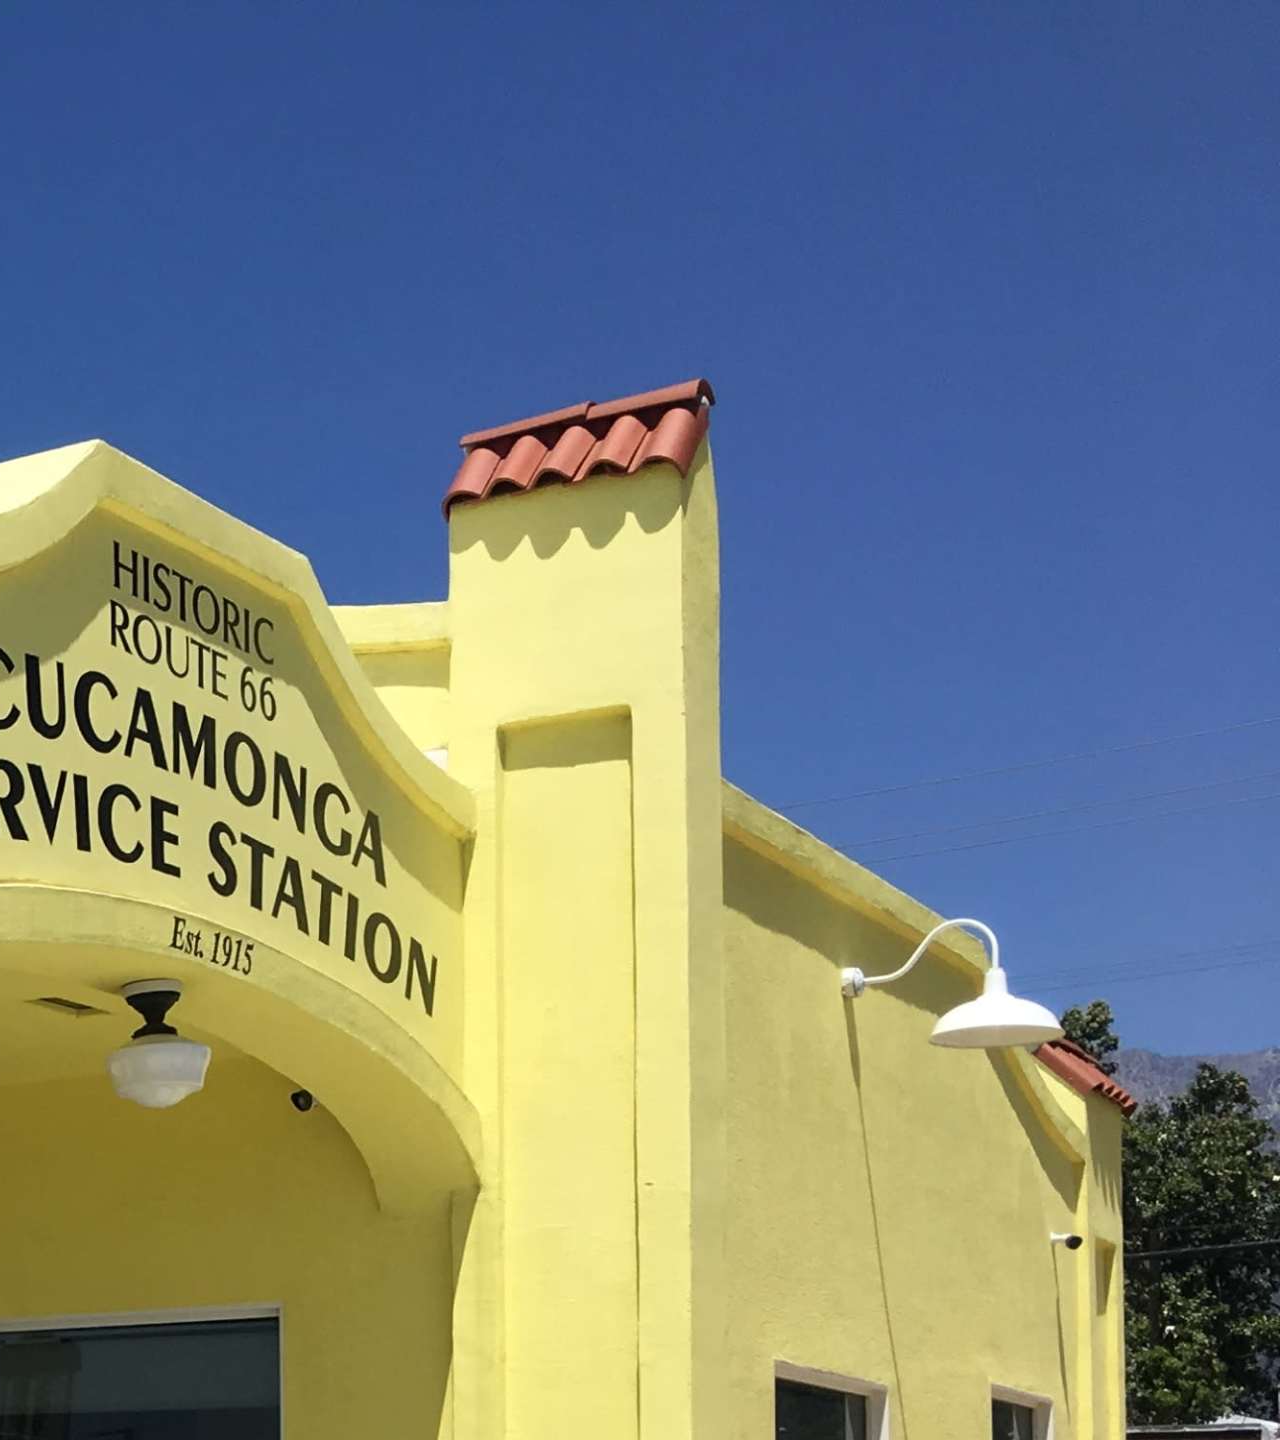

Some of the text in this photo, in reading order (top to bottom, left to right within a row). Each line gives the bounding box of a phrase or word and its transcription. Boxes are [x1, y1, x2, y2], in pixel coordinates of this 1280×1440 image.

[110, 600, 277, 722] ROUTE 66
[113, 540, 274, 665] HISTORIC
[168, 915, 255, 976] Est. 1915
[206, 820, 438, 1017] STATION
